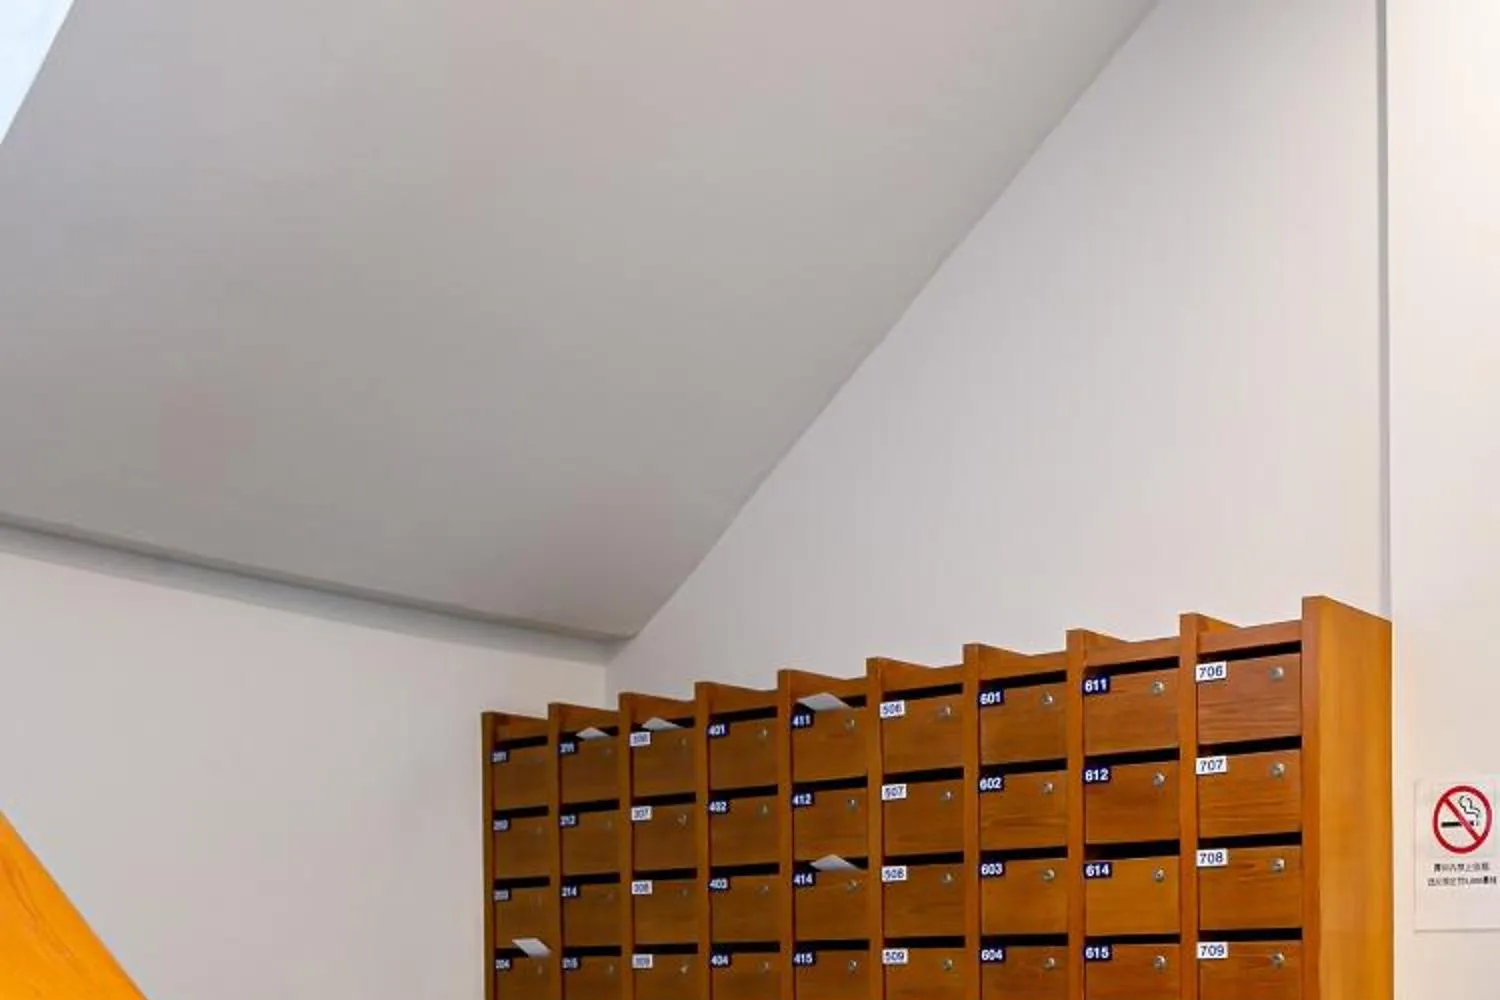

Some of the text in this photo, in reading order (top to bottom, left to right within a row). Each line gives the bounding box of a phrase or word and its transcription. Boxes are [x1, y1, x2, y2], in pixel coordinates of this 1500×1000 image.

[1198, 664, 1223, 679] 706
[1084, 677, 1108, 693] 611
[980, 691, 1001, 705] 601
[793, 715, 810, 726] 411
[1200, 758, 1224, 772] 707
[1085, 767, 1110, 783] 612
[979, 777, 1001, 790] 602
[884, 785, 905, 798] 507
[793, 793, 811, 805] 412
[1199, 851, 1224, 864] 708
[981, 863, 1003, 875] 603
[1086, 864, 1109, 877] 614
[794, 874, 813, 884] 414
[981, 949, 1003, 961] 604
[1085, 946, 1110, 960] 615
[1200, 944, 1225, 957] 709
[794, 953, 813, 963] 415
